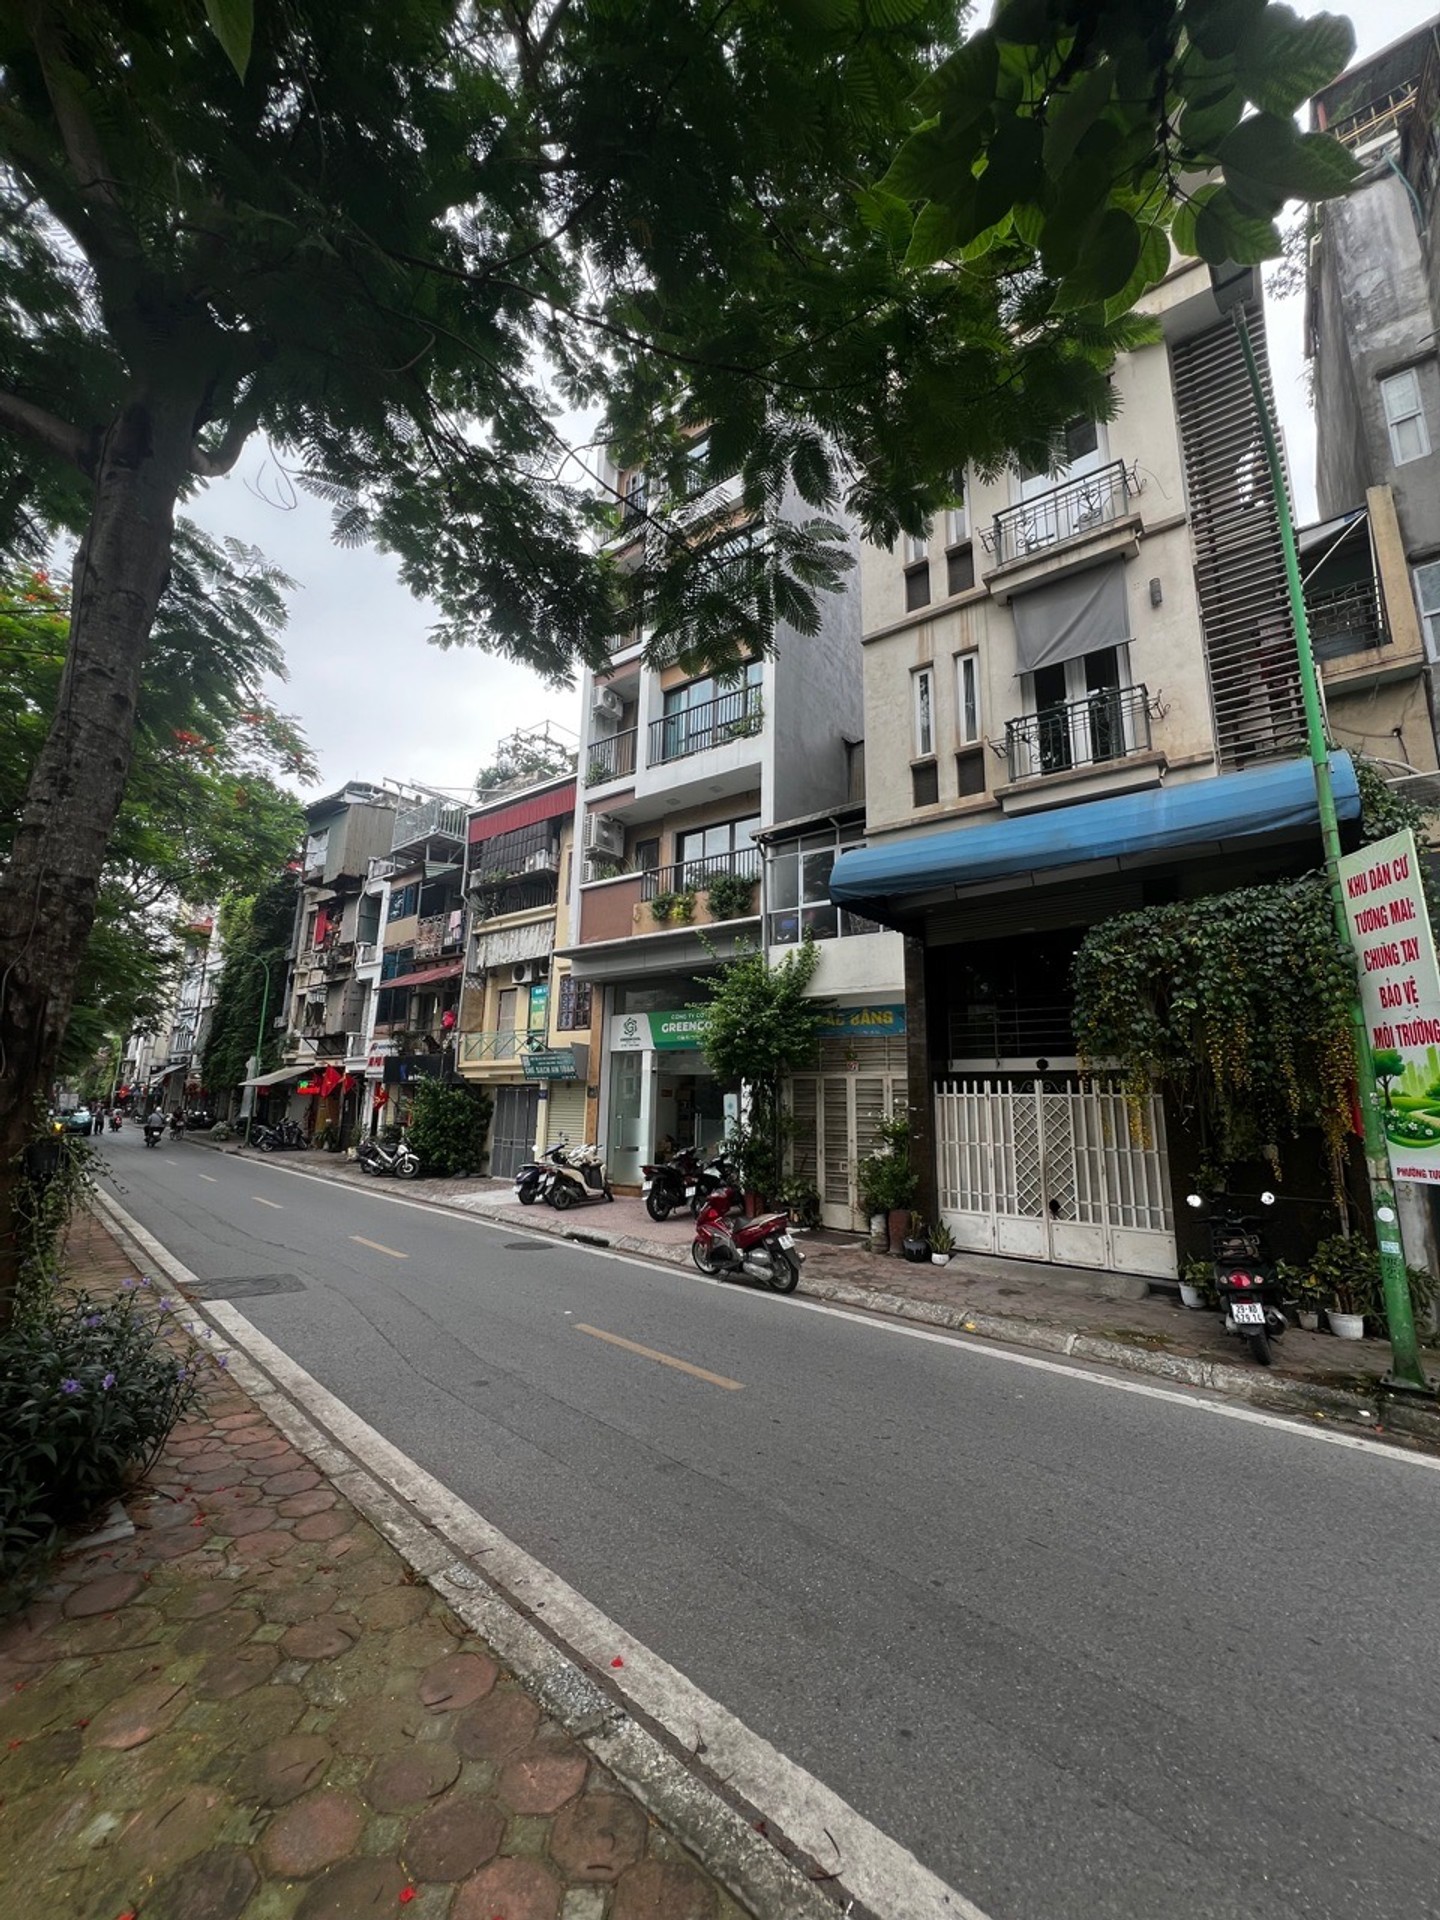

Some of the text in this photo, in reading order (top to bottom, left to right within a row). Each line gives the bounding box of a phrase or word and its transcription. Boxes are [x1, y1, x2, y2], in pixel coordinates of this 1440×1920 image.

[1347, 853, 1409, 899] KHU DÂN CƯ
[1354, 905, 1389, 935] TƯƠNG
[1400, 937, 1420, 962] TAY
[1379, 975, 1419, 1009] BẢO VỆ
[1373, 1016, 1440, 1050] MÔI TRƯỜNG
[1428, 1169, 1440, 1180] TƯ
